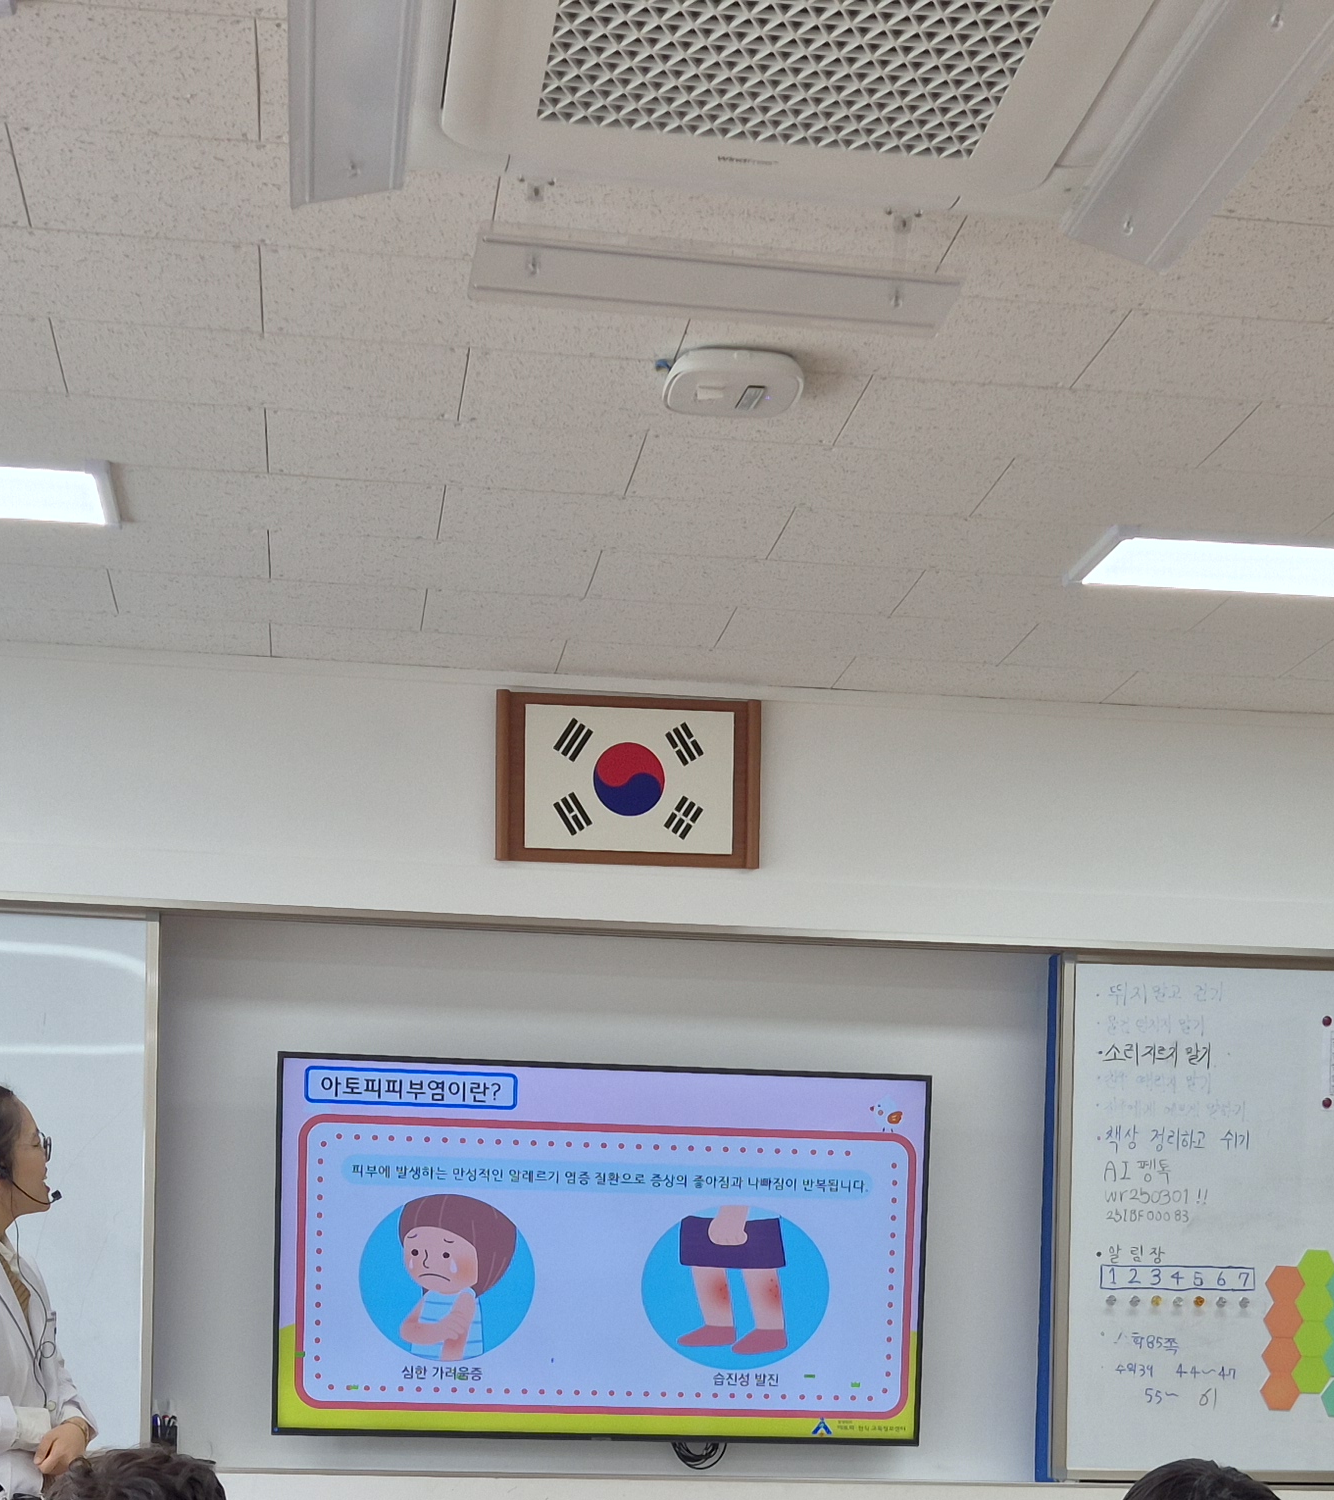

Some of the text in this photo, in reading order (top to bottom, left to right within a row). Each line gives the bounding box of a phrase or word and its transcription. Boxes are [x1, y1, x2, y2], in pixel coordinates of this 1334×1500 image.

[1185, 1041, 1211, 1069] 말기
[320, 1075, 502, 1103] 아토피피부염이란?
[1105, 1124, 1250, 1153] 책상 정리하고 쉬기
[351, 1164, 869, 1194] 피부에 발생하는 만성적인 알레르기 염증 질환으로 증상의 좋아짐과 나빠짐이 반복됩니다.
[1103, 1158, 1171, 1185] AI 펭톡
[1109, 1267, 1250, 1287] 1 2 3 4 5 6 7
[401, 1365, 483, 1382] 심한 가려움증
[713, 1372, 780, 1388] 습진성 발진
